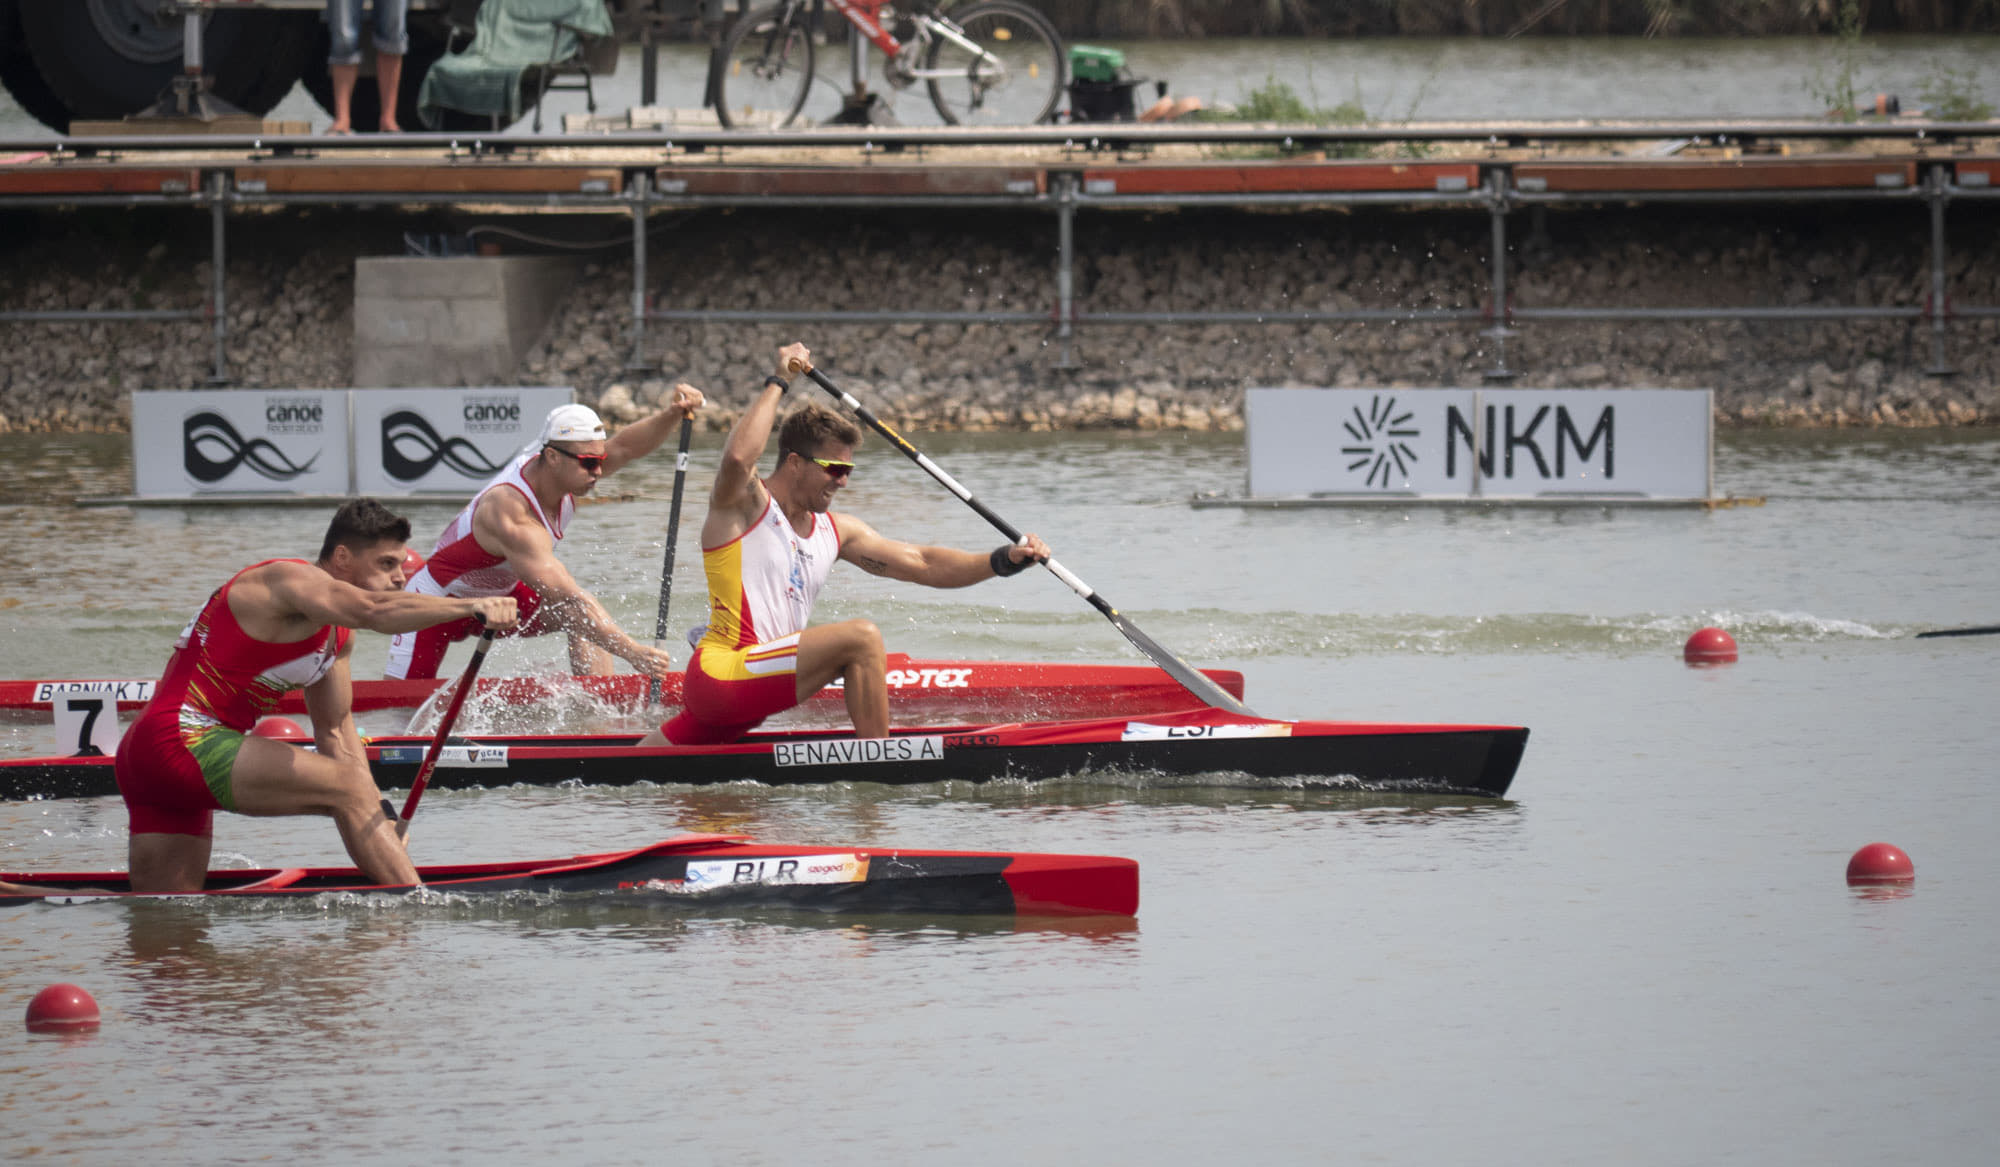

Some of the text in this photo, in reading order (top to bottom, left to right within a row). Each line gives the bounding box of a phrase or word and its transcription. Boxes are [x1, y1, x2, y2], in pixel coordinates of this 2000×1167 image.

[266, 404, 323, 422] canoe
[464, 403, 520, 421] canoe
[1446, 404, 1614, 479] NKM
[67, 699, 103, 750] 7
[776, 737, 942, 766] BENAVIDES A.
